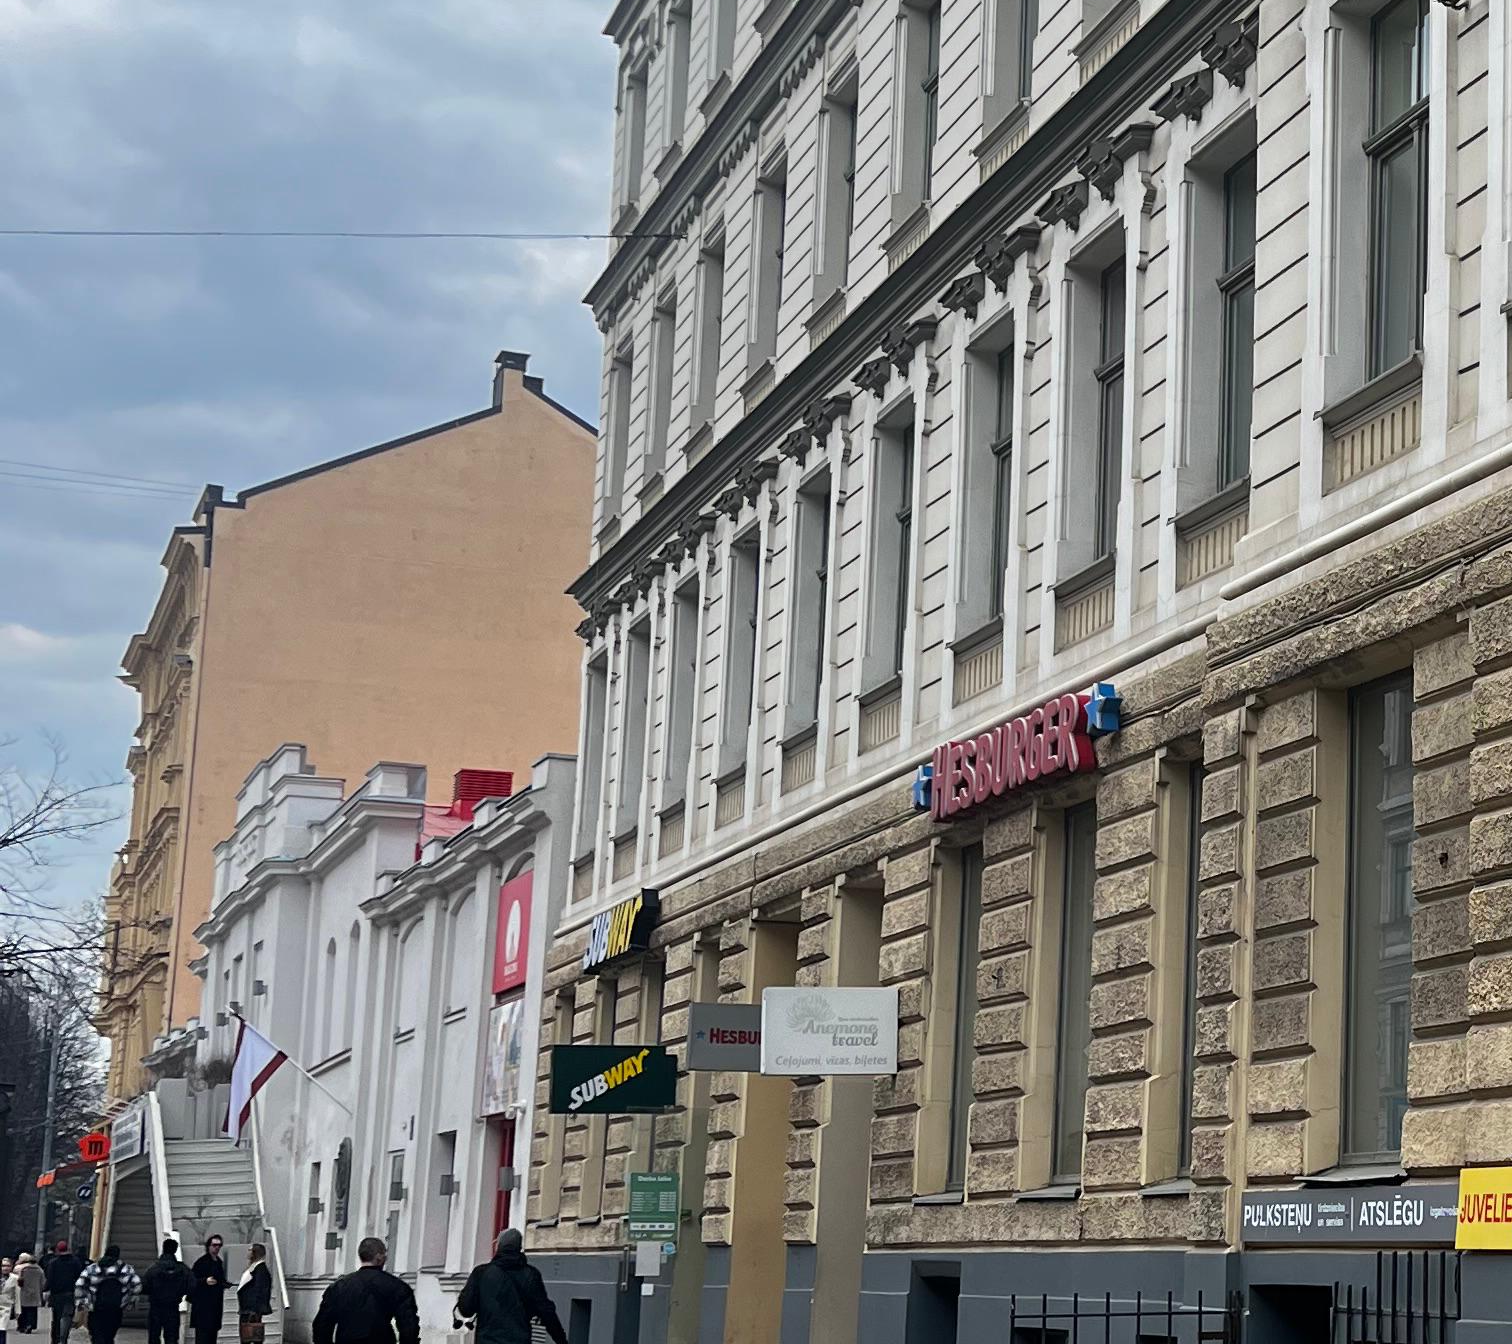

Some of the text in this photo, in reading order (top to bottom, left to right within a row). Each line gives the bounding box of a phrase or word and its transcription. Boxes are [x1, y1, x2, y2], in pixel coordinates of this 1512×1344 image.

[930, 693, 1080, 819] HESBURGER
[583, 895, 643, 970] SUBWAY
[709, 1027, 762, 1046] HESBU
[802, 1019, 879, 1035] Anemone
[832, 1029, 879, 1047] travel
[567, 1048, 650, 1111] SUBWAY
[1243, 1203, 1312, 1234] PULKSTEŅU
[1359, 1195, 1424, 1226] ATSLĒGU
